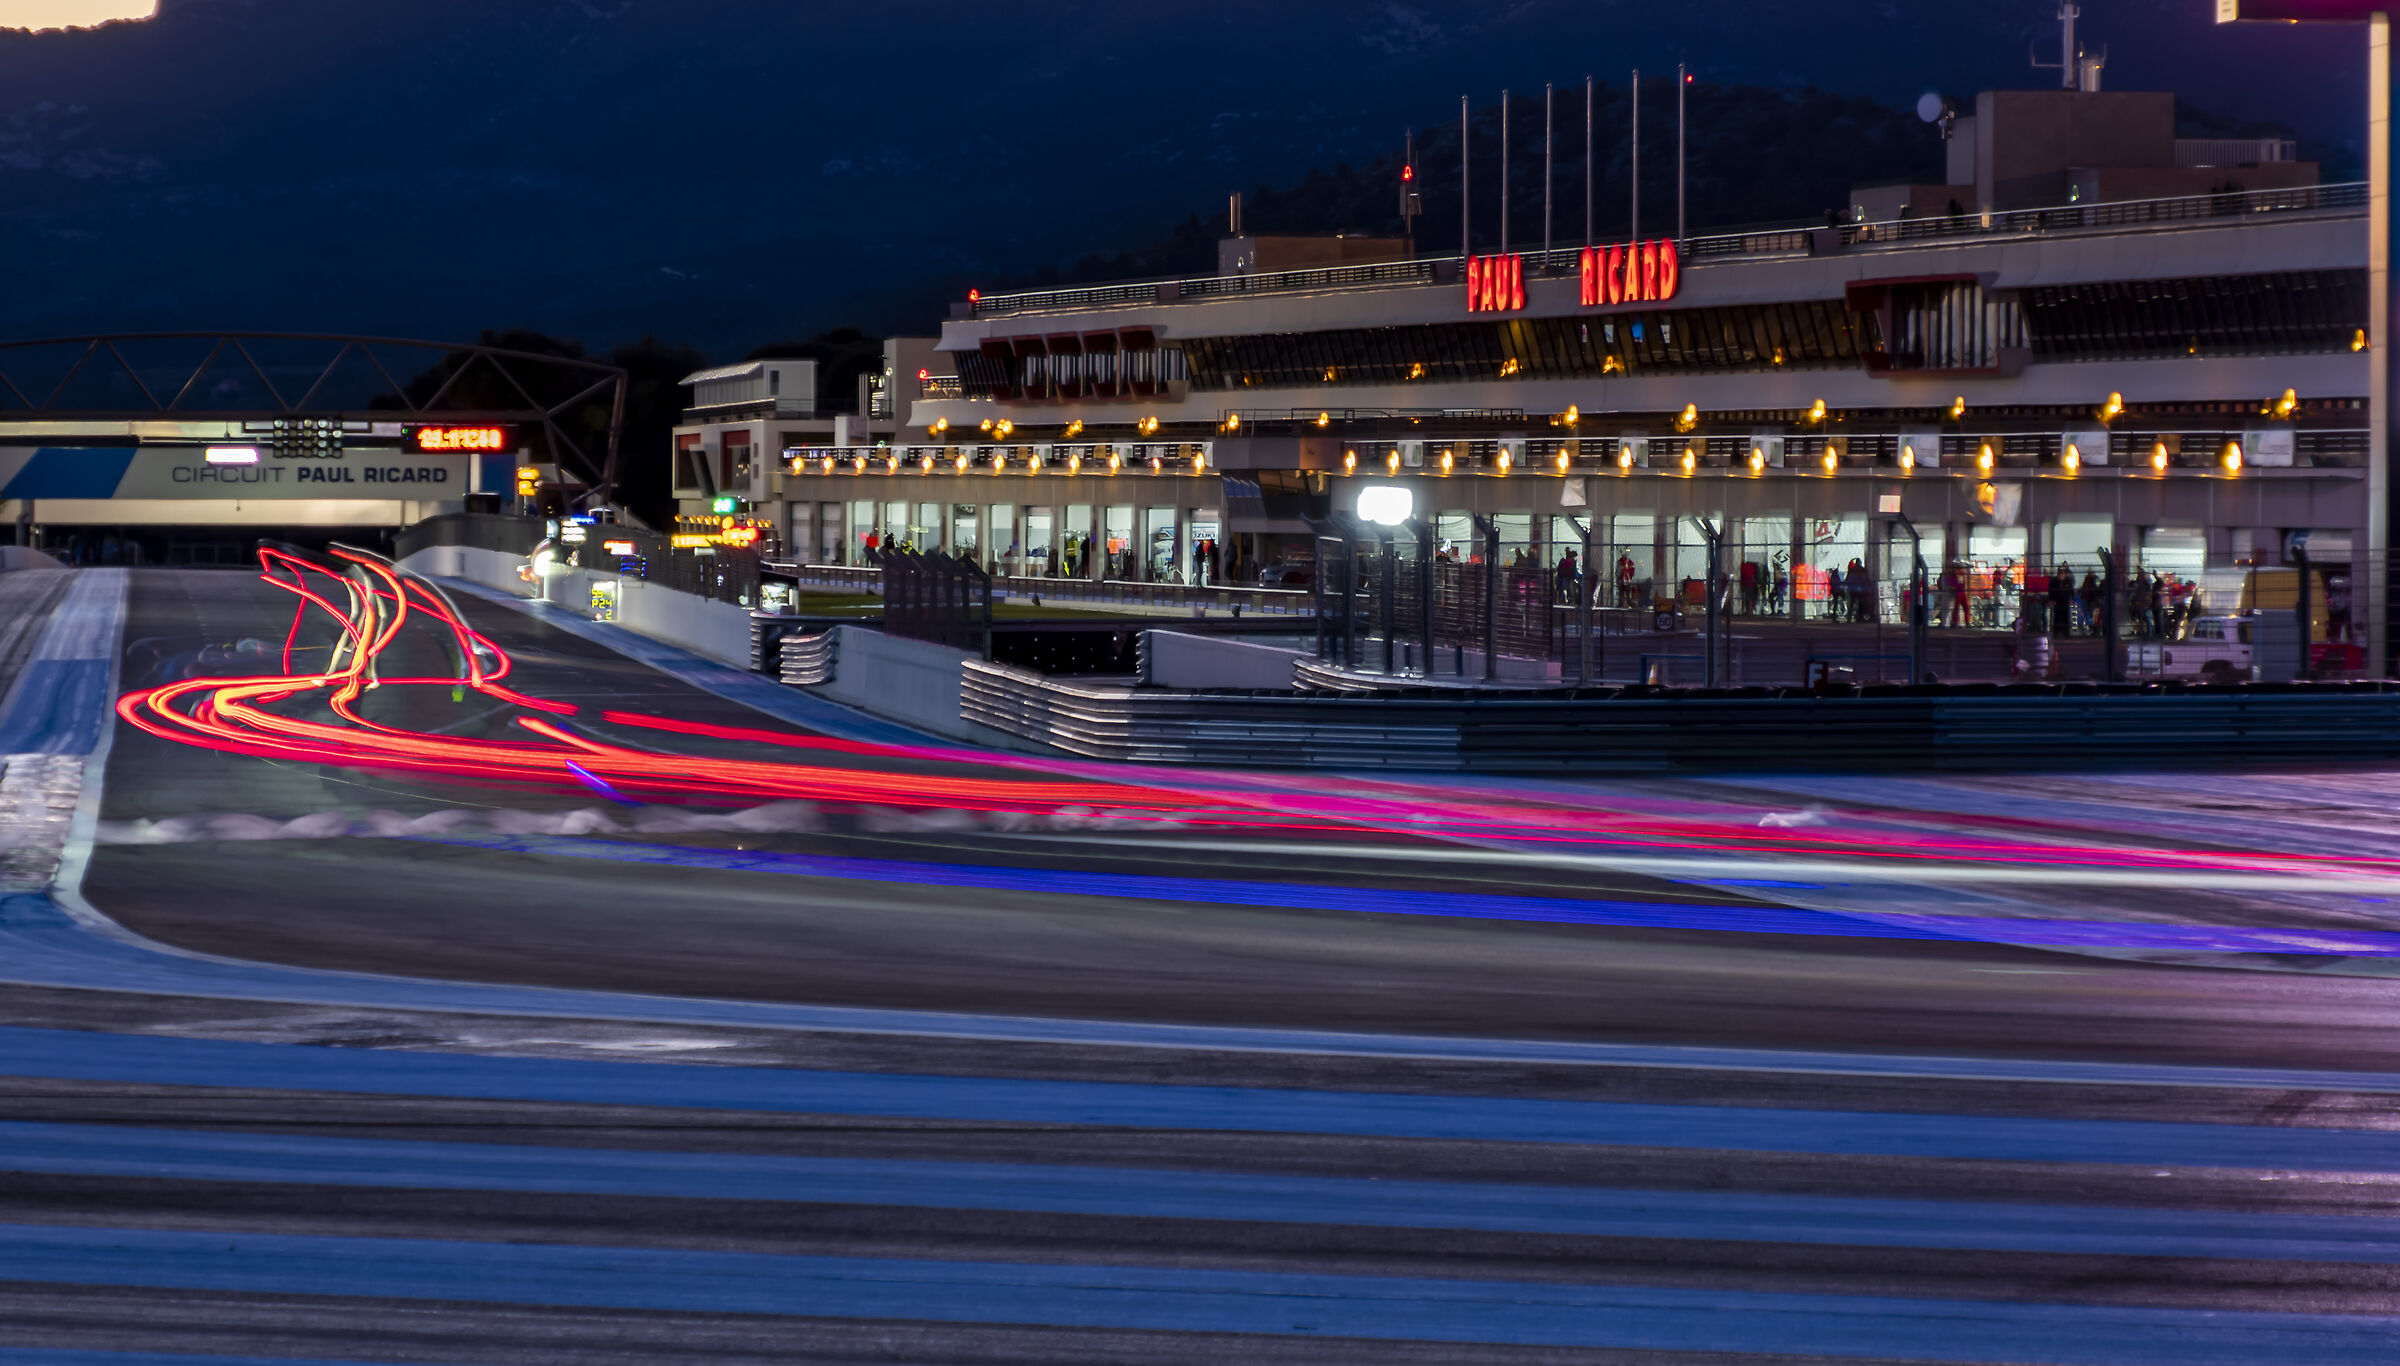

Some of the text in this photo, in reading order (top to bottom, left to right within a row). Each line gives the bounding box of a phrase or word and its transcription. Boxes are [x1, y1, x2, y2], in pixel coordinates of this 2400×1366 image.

[1467, 238, 1678, 312] PAUL RICARD
[172, 466, 448, 483] CIRCUIT PAUL RICARD
